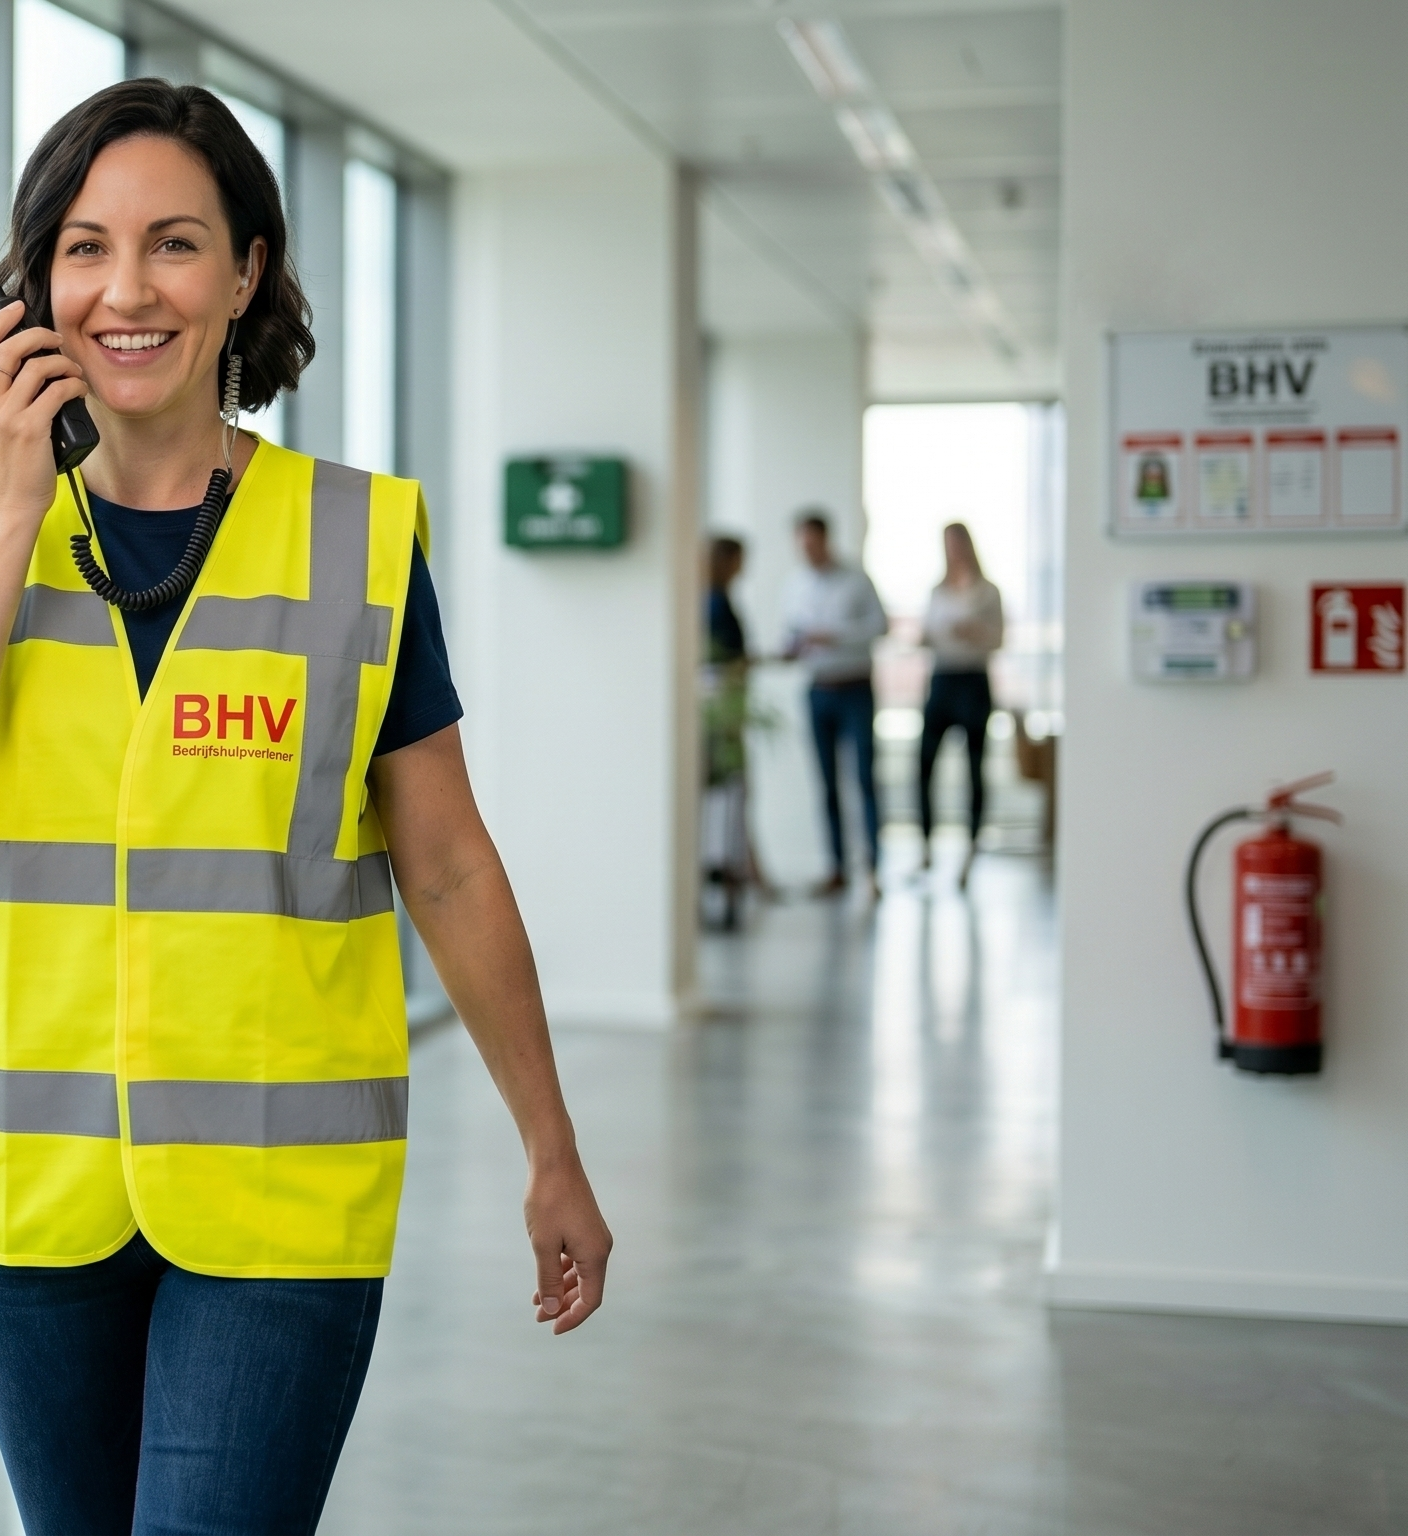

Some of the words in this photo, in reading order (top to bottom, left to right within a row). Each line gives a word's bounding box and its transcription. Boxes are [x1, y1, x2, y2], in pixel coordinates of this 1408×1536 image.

[1208, 359, 1314, 398] BHV
[173, 694, 298, 743] BHV
[172, 745, 294, 762] Bedrijfshulpverlener
